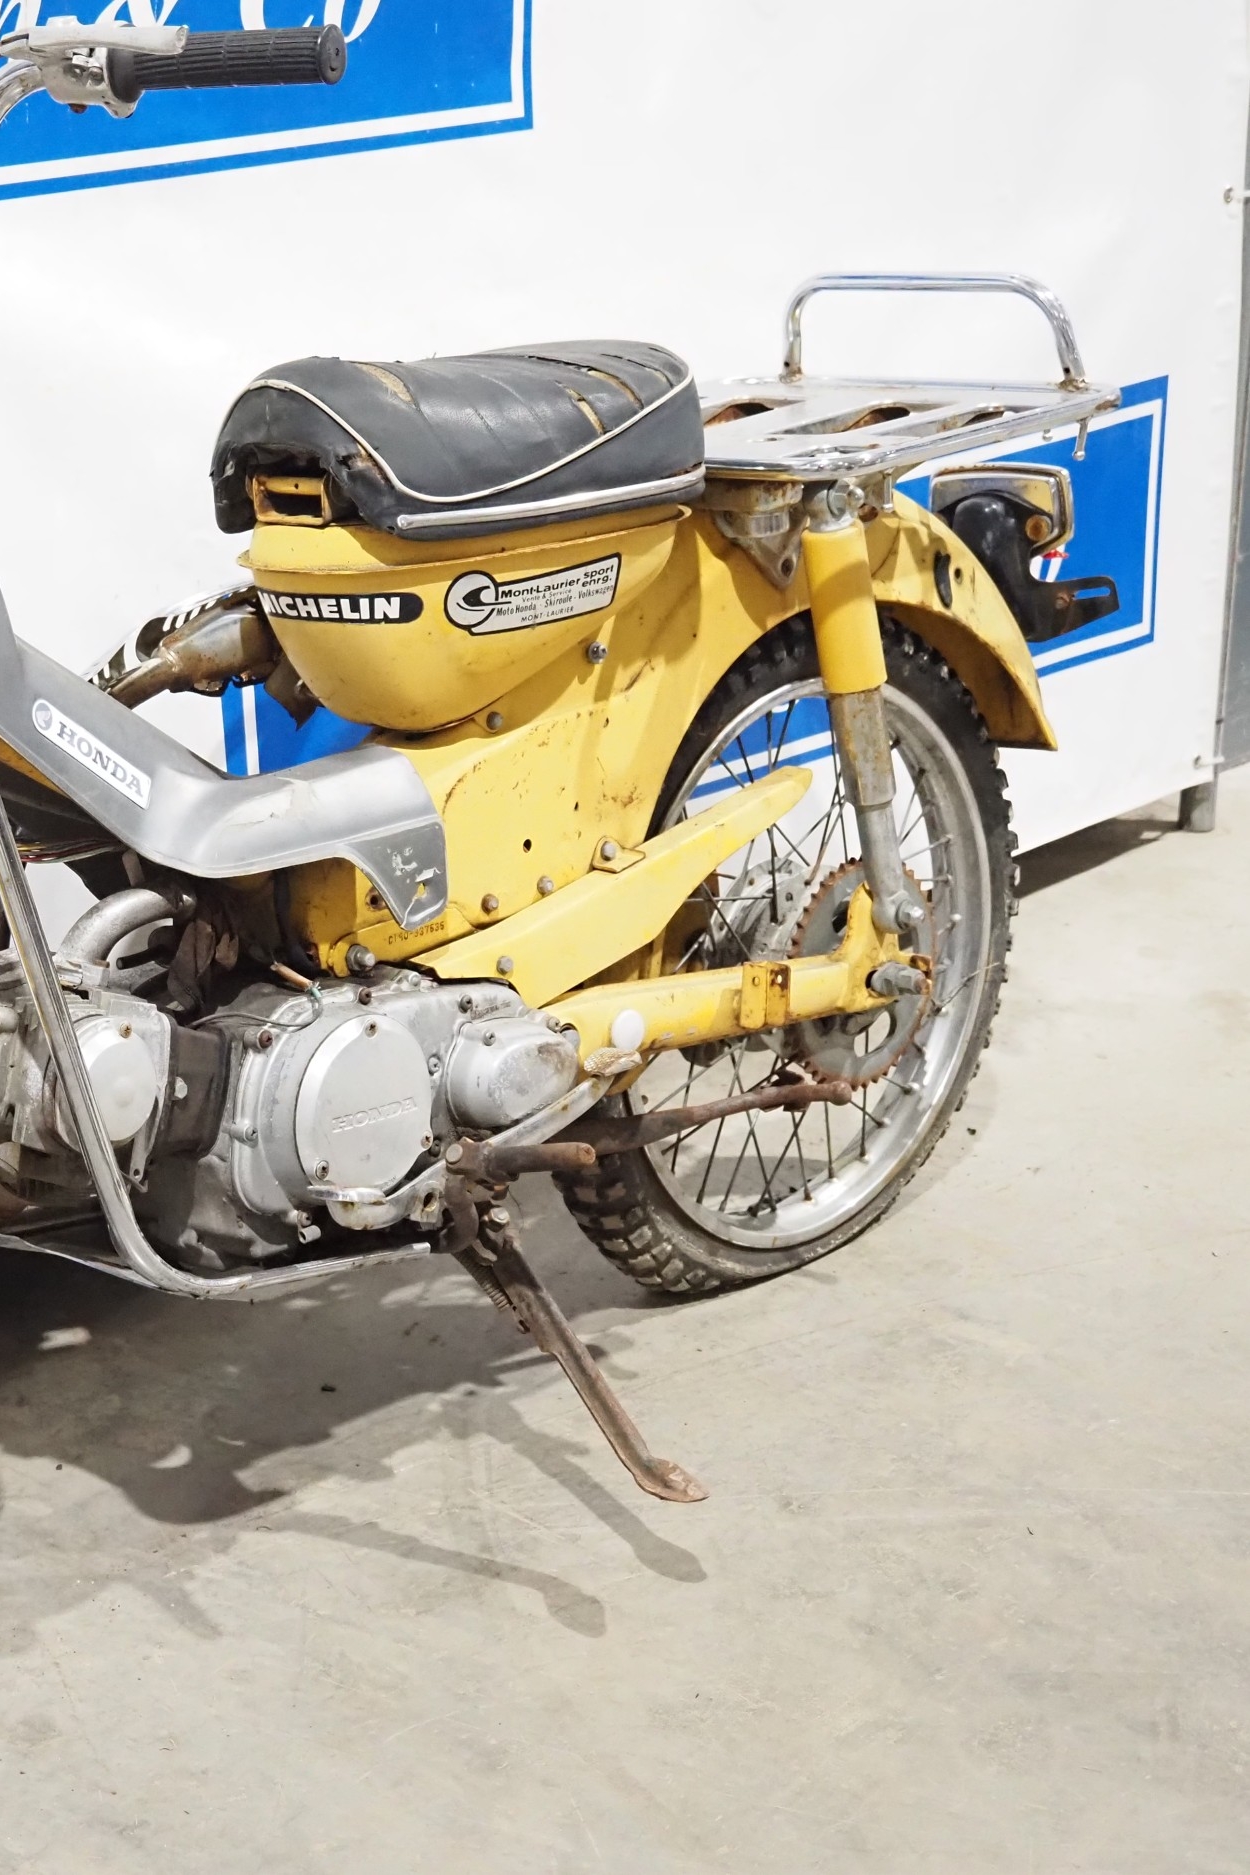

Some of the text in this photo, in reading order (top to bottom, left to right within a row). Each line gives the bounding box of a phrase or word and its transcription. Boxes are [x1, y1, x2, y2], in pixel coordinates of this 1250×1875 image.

[581, 575, 612, 588] enrg.
[583, 564, 614, 582] sport
[257, 591, 401, 620] MICHELIN
[496, 607, 515, 617] Moto
[515, 602, 537, 614] Honda
[578, 584, 614, 601] Volkswagen
[549, 588, 572, 598] Service
[56, 721, 144, 798] HONDA
[332, 1096, 419, 1133] HONDA
